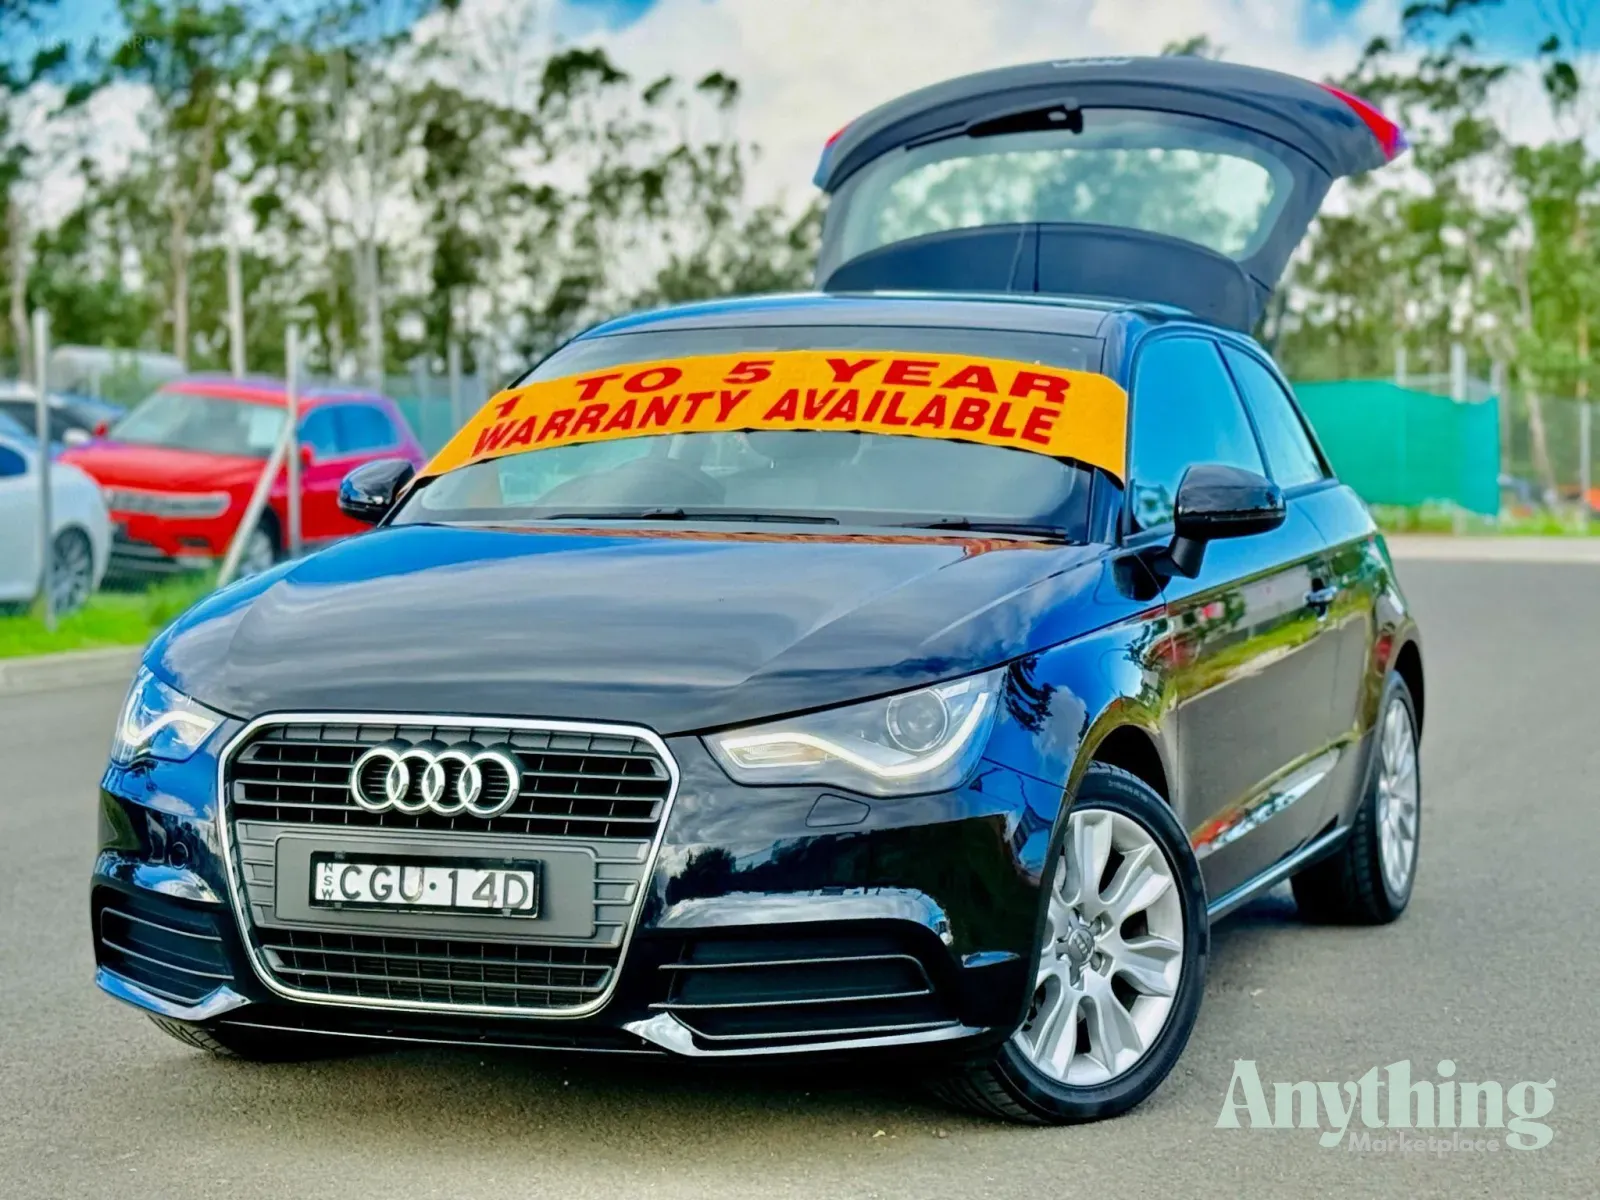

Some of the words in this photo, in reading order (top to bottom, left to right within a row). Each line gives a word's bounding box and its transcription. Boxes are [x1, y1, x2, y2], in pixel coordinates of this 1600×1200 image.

[471, 389, 752, 457] WARRANTY
[762, 388, 1062, 446] AVAILABLE
[495, 395, 524, 421] 1
[574, 366, 683, 403] TO
[722, 360, 776, 385] 5
[825, 358, 1072, 405] YEAR
